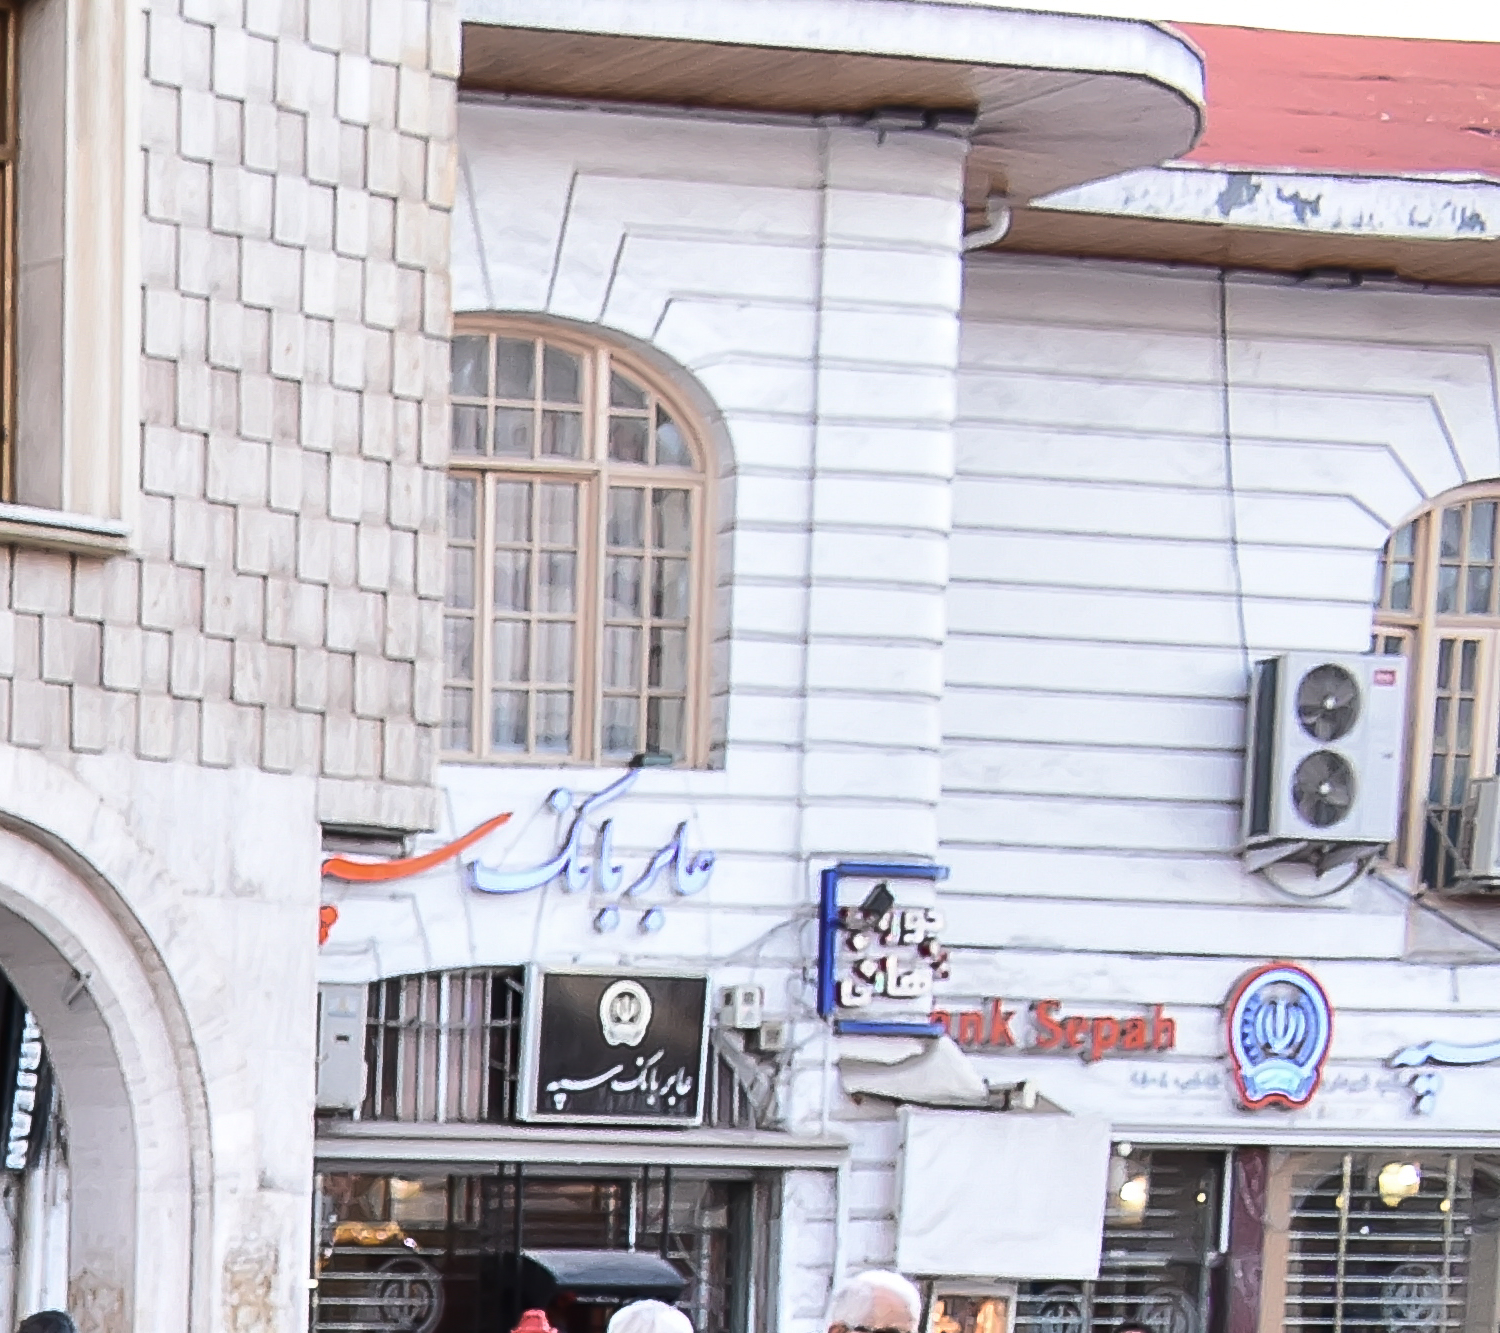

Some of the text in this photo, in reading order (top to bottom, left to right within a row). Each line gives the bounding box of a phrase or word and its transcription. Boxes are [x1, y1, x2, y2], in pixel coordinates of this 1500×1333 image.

[466, 768, 642, 937] بانک
[1035, 997, 1177, 1063] Sepah
[545, 1048, 694, 1111] عابر بانک سپه
